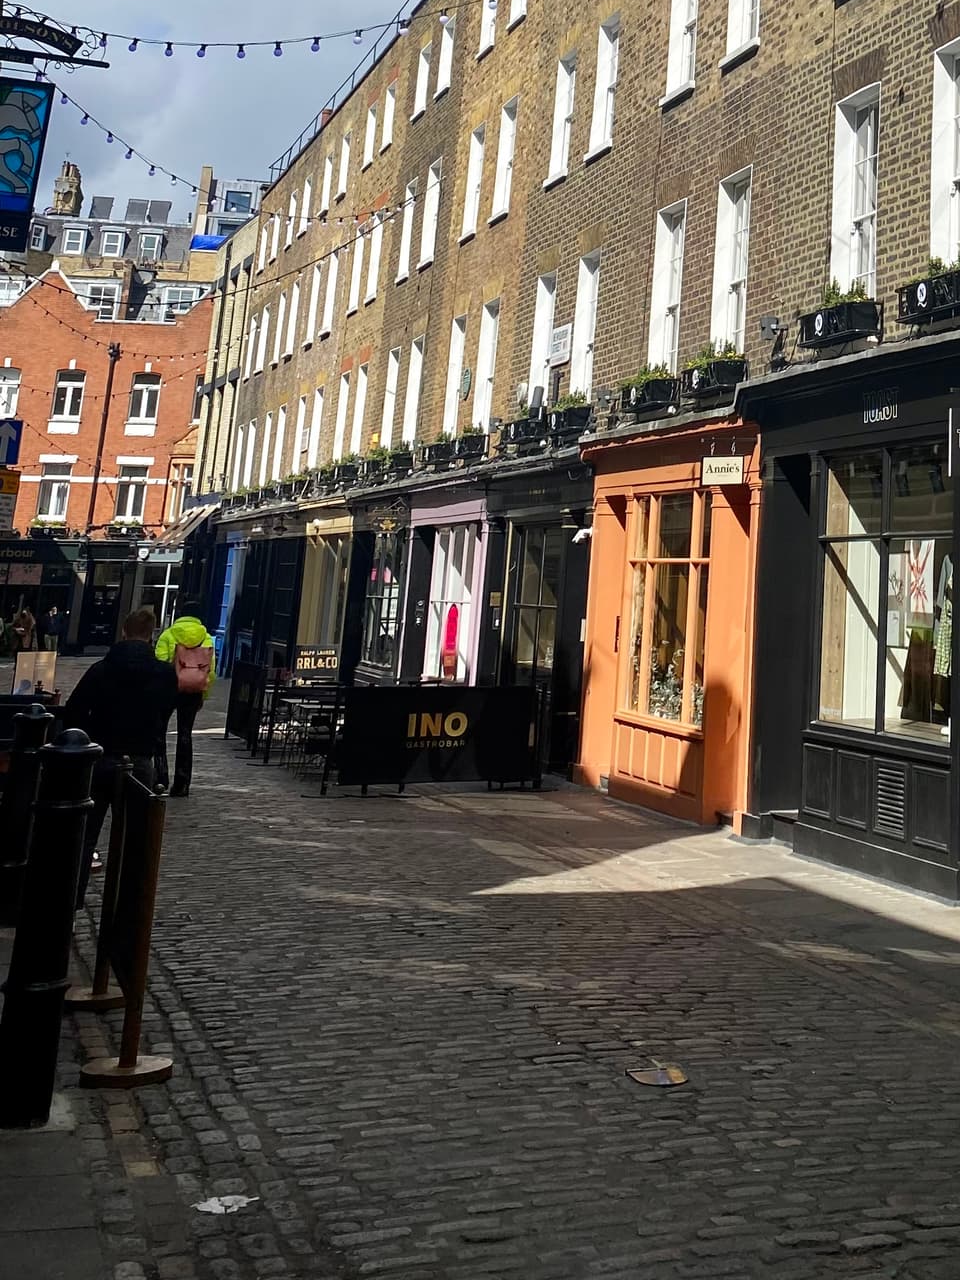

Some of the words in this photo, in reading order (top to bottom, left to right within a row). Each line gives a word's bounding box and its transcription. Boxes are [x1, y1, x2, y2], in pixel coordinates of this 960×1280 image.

[863, 389, 899, 424] TOAST
[705, 463, 740, 474] Annie's
[296, 656, 338, 670] RRL&CO
[407, 711, 468, 737] INO
[406, 739, 466, 749] GASTROBAR
